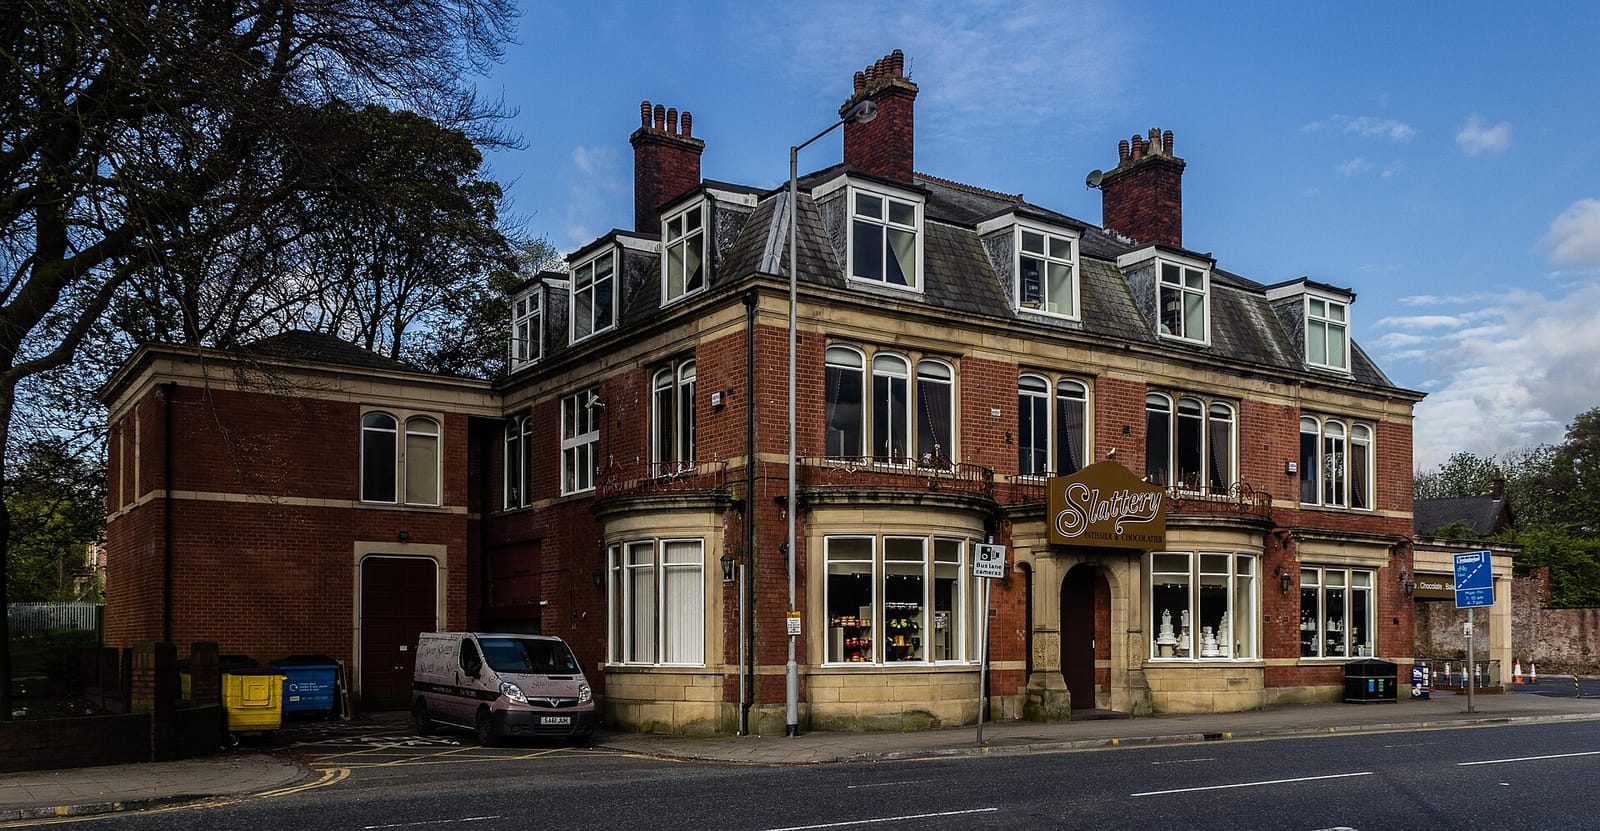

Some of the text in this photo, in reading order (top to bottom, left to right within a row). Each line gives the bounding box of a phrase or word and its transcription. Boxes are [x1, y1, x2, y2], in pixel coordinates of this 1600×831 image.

[1055, 482, 1163, 538] Slattery
[1084, 531, 1112, 541] PATISSIER
[1121, 533, 1163, 544] CHOCOLATIER
[1419, 581, 1443, 590] Chocolate
